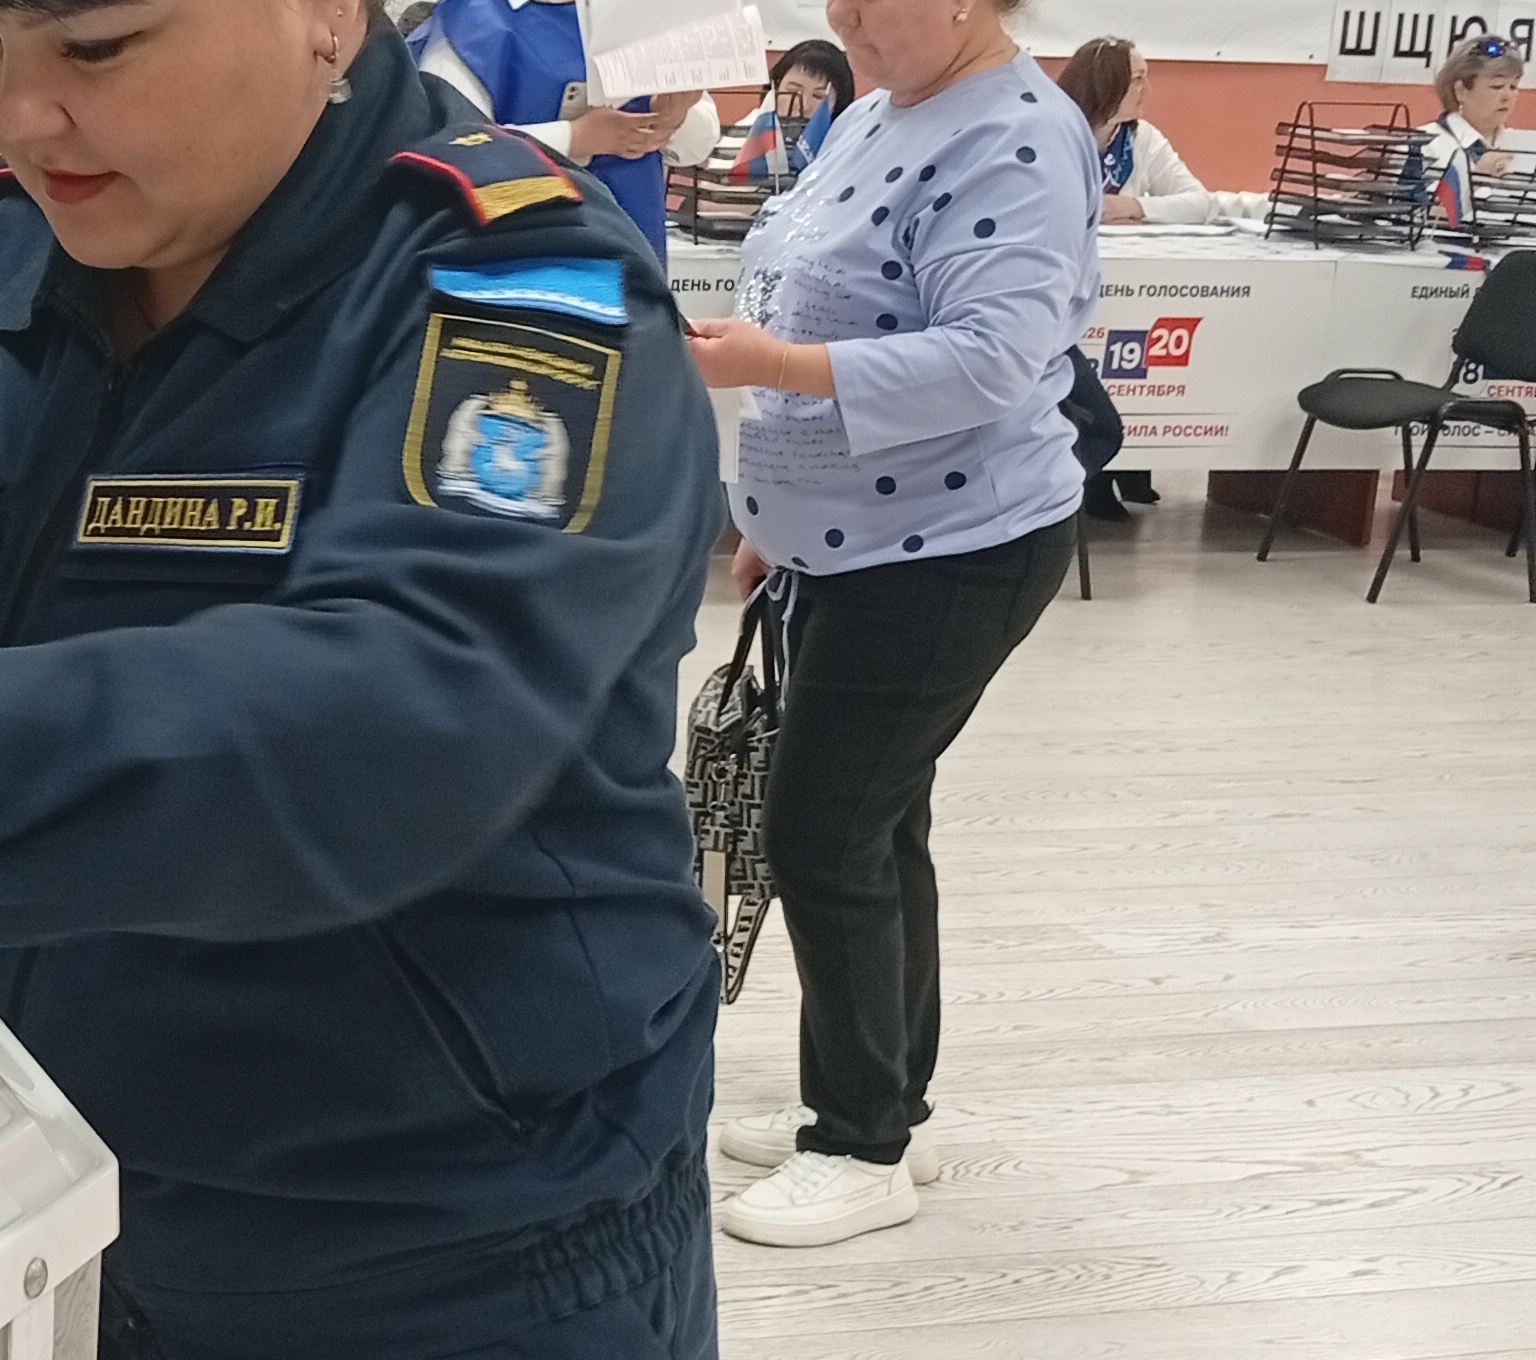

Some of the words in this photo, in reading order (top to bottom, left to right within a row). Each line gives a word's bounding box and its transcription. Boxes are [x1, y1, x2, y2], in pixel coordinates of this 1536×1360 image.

[1339, 10, 1381, 56] Ш
[1393, 13, 1435, 68] Щ
[670, 278, 712, 293] ДЕНЬ
[1137, 284, 1251, 298] ГОЛОСОВАНИЯ
[1410, 284, 1470, 300] ЕДИНЫЙ
[1108, 341, 1141, 370] 19
[1148, 327, 1190, 357] 20
[1106, 384, 1186, 397] СЕНТЯБРЯ
[1487, 384, 1536, 398] СЕНТЯ
[1162, 424, 1229, 438] РОССИИ!
[85, 496, 220, 536] ДАНДИНА
